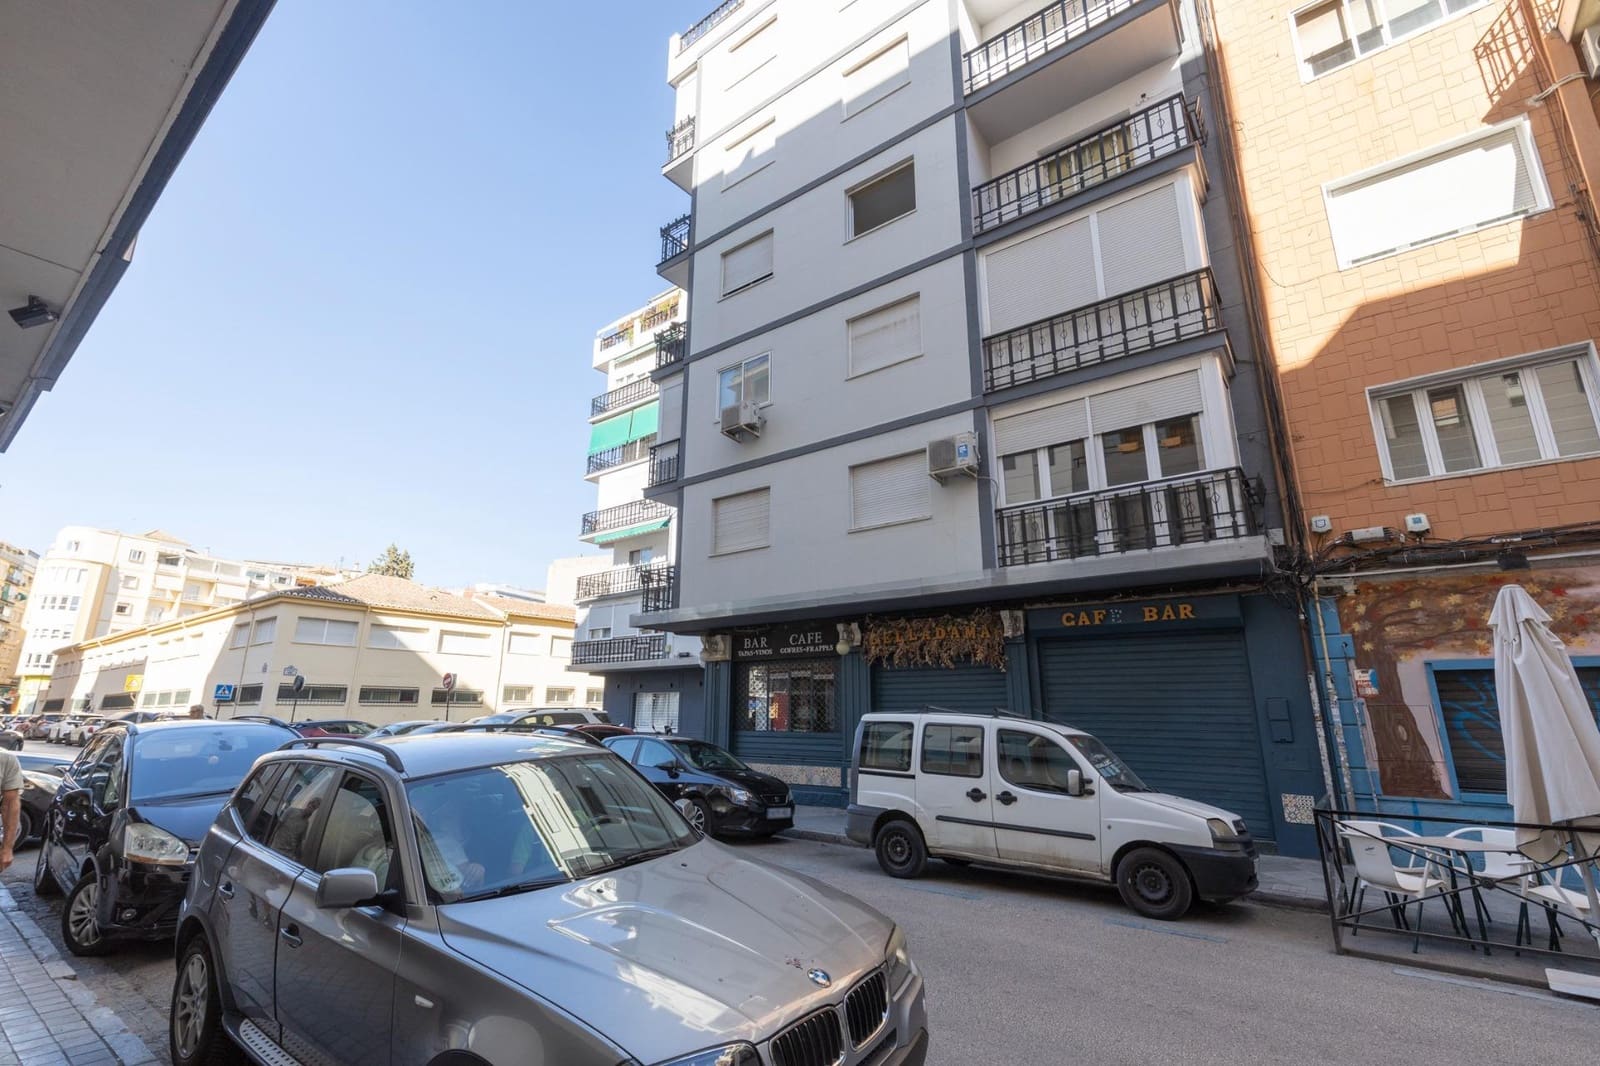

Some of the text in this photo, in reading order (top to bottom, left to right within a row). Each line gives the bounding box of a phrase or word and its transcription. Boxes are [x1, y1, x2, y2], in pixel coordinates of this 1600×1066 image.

[1143, 604, 1196, 621] BAR
[744, 631, 823, 649] BAR CAFE
